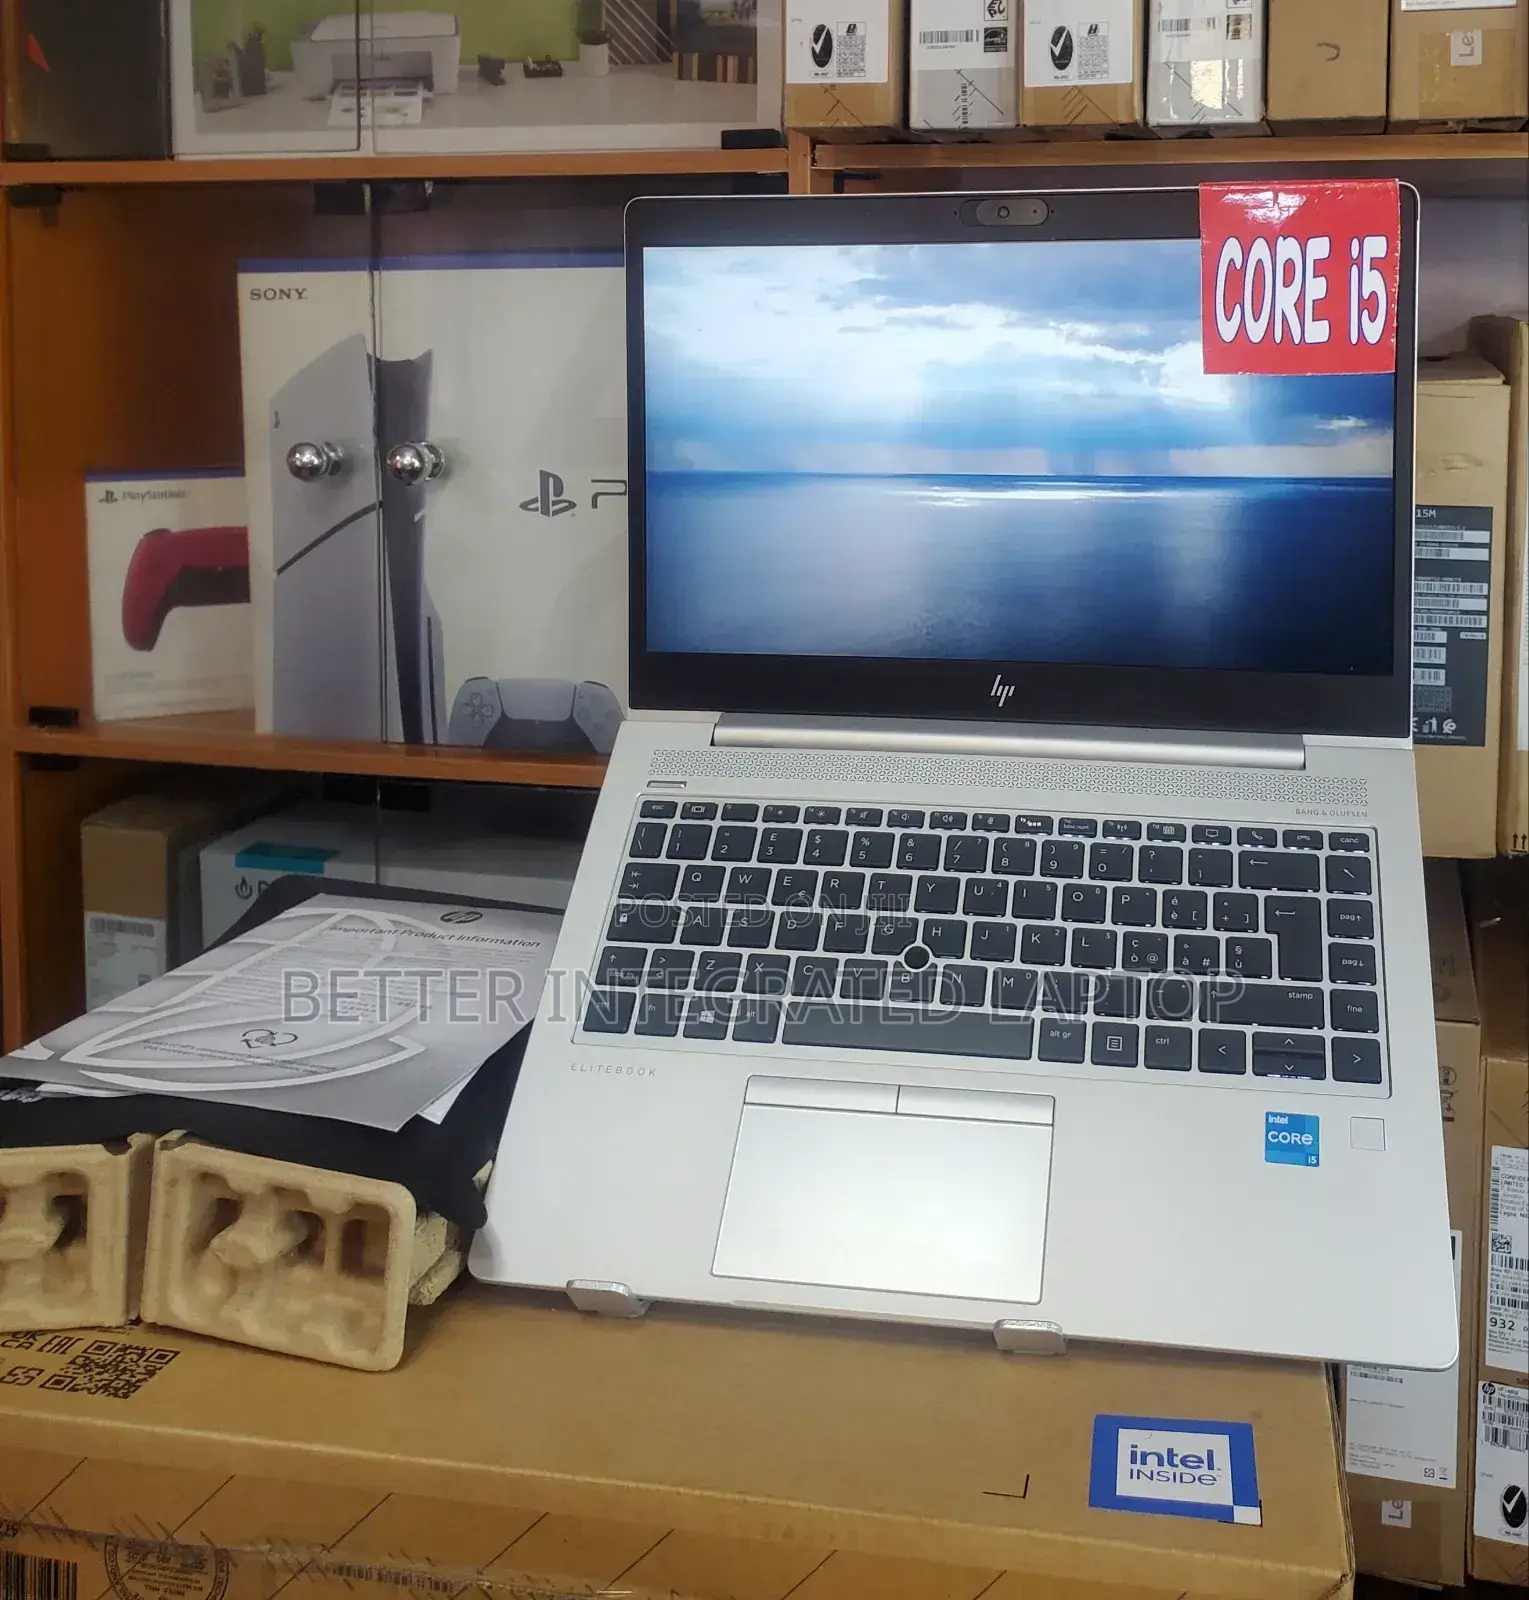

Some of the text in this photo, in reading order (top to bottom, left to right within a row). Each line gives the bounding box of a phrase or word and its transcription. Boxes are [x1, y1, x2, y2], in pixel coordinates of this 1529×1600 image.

[250, 288, 307, 301] SONY
[1215, 235, 1388, 345] CORE i5
[122, 489, 186, 503] PlayStation
[990, 674, 1016, 708] hp
[1295, 808, 1319, 816] BANG
[1329, 809, 1368, 818] OLUFSEN
[770, 833, 777, 841] £
[814, 835, 821, 844] $
[861, 837, 870, 846] %
[675, 843, 680, 851] 1
[906, 838, 915, 847] &
[720, 845, 728, 853] 2
[766, 847, 774, 855] 3
[812, 849, 820, 857] 4
[858, 851, 866, 860] 5
[905, 853, 913, 862] 6
[953, 855, 961, 864] 7
[1148, 851, 1155, 859] ?
[1001, 858, 1009, 867] 8
[1050, 861, 1058, 870] 9
[691, 872, 702, 882] Q
[738, 874, 752, 884] W
[782, 876, 792, 886] E
[830, 879, 840, 889] R
[878, 881, 886, 889] T
[926, 883, 936, 893] Y
[974, 886, 984, 895] U
[1023, 888, 1027, 898] I
[1072, 892, 1083, 901] O
[1121, 895, 1131, 904] P
[692, 915, 703, 925] A
[1340, 913, 1355, 921] pag
[740, 918, 748, 927] S
[787, 920, 797, 930] D
[834, 922, 843, 932] F
[884, 924, 894, 934] G
[932, 927, 942, 937] H
[329, 925, 541, 948] Important Product Information
[981, 930, 989, 940] J
[1031, 933, 1041, 944] K
[1081, 937, 1090, 947] L
[1147, 953, 1159, 963] @
[1202, 957, 1210, 967] #
[1341, 958, 1358, 967] pag
[705, 960, 716, 970] Z
[754, 962, 764, 972] X
[803, 965, 813, 975] C
[853, 968, 863, 978] V
[901, 973, 910, 982] B
[951, 973, 962, 983] N
[1002, 977, 1014, 988] M
[1288, 991, 1313, 1000] stamp
[1347, 1005, 1363, 1013] fine
[1155, 1037, 1170, 1045] ctrl
[570, 1062, 656, 1077] ELITEBOOK
[1268, 1114, 1289, 1125] intel
[1308, 1155, 1317, 1164] i5
[1489, 1316, 1515, 1331] 932
